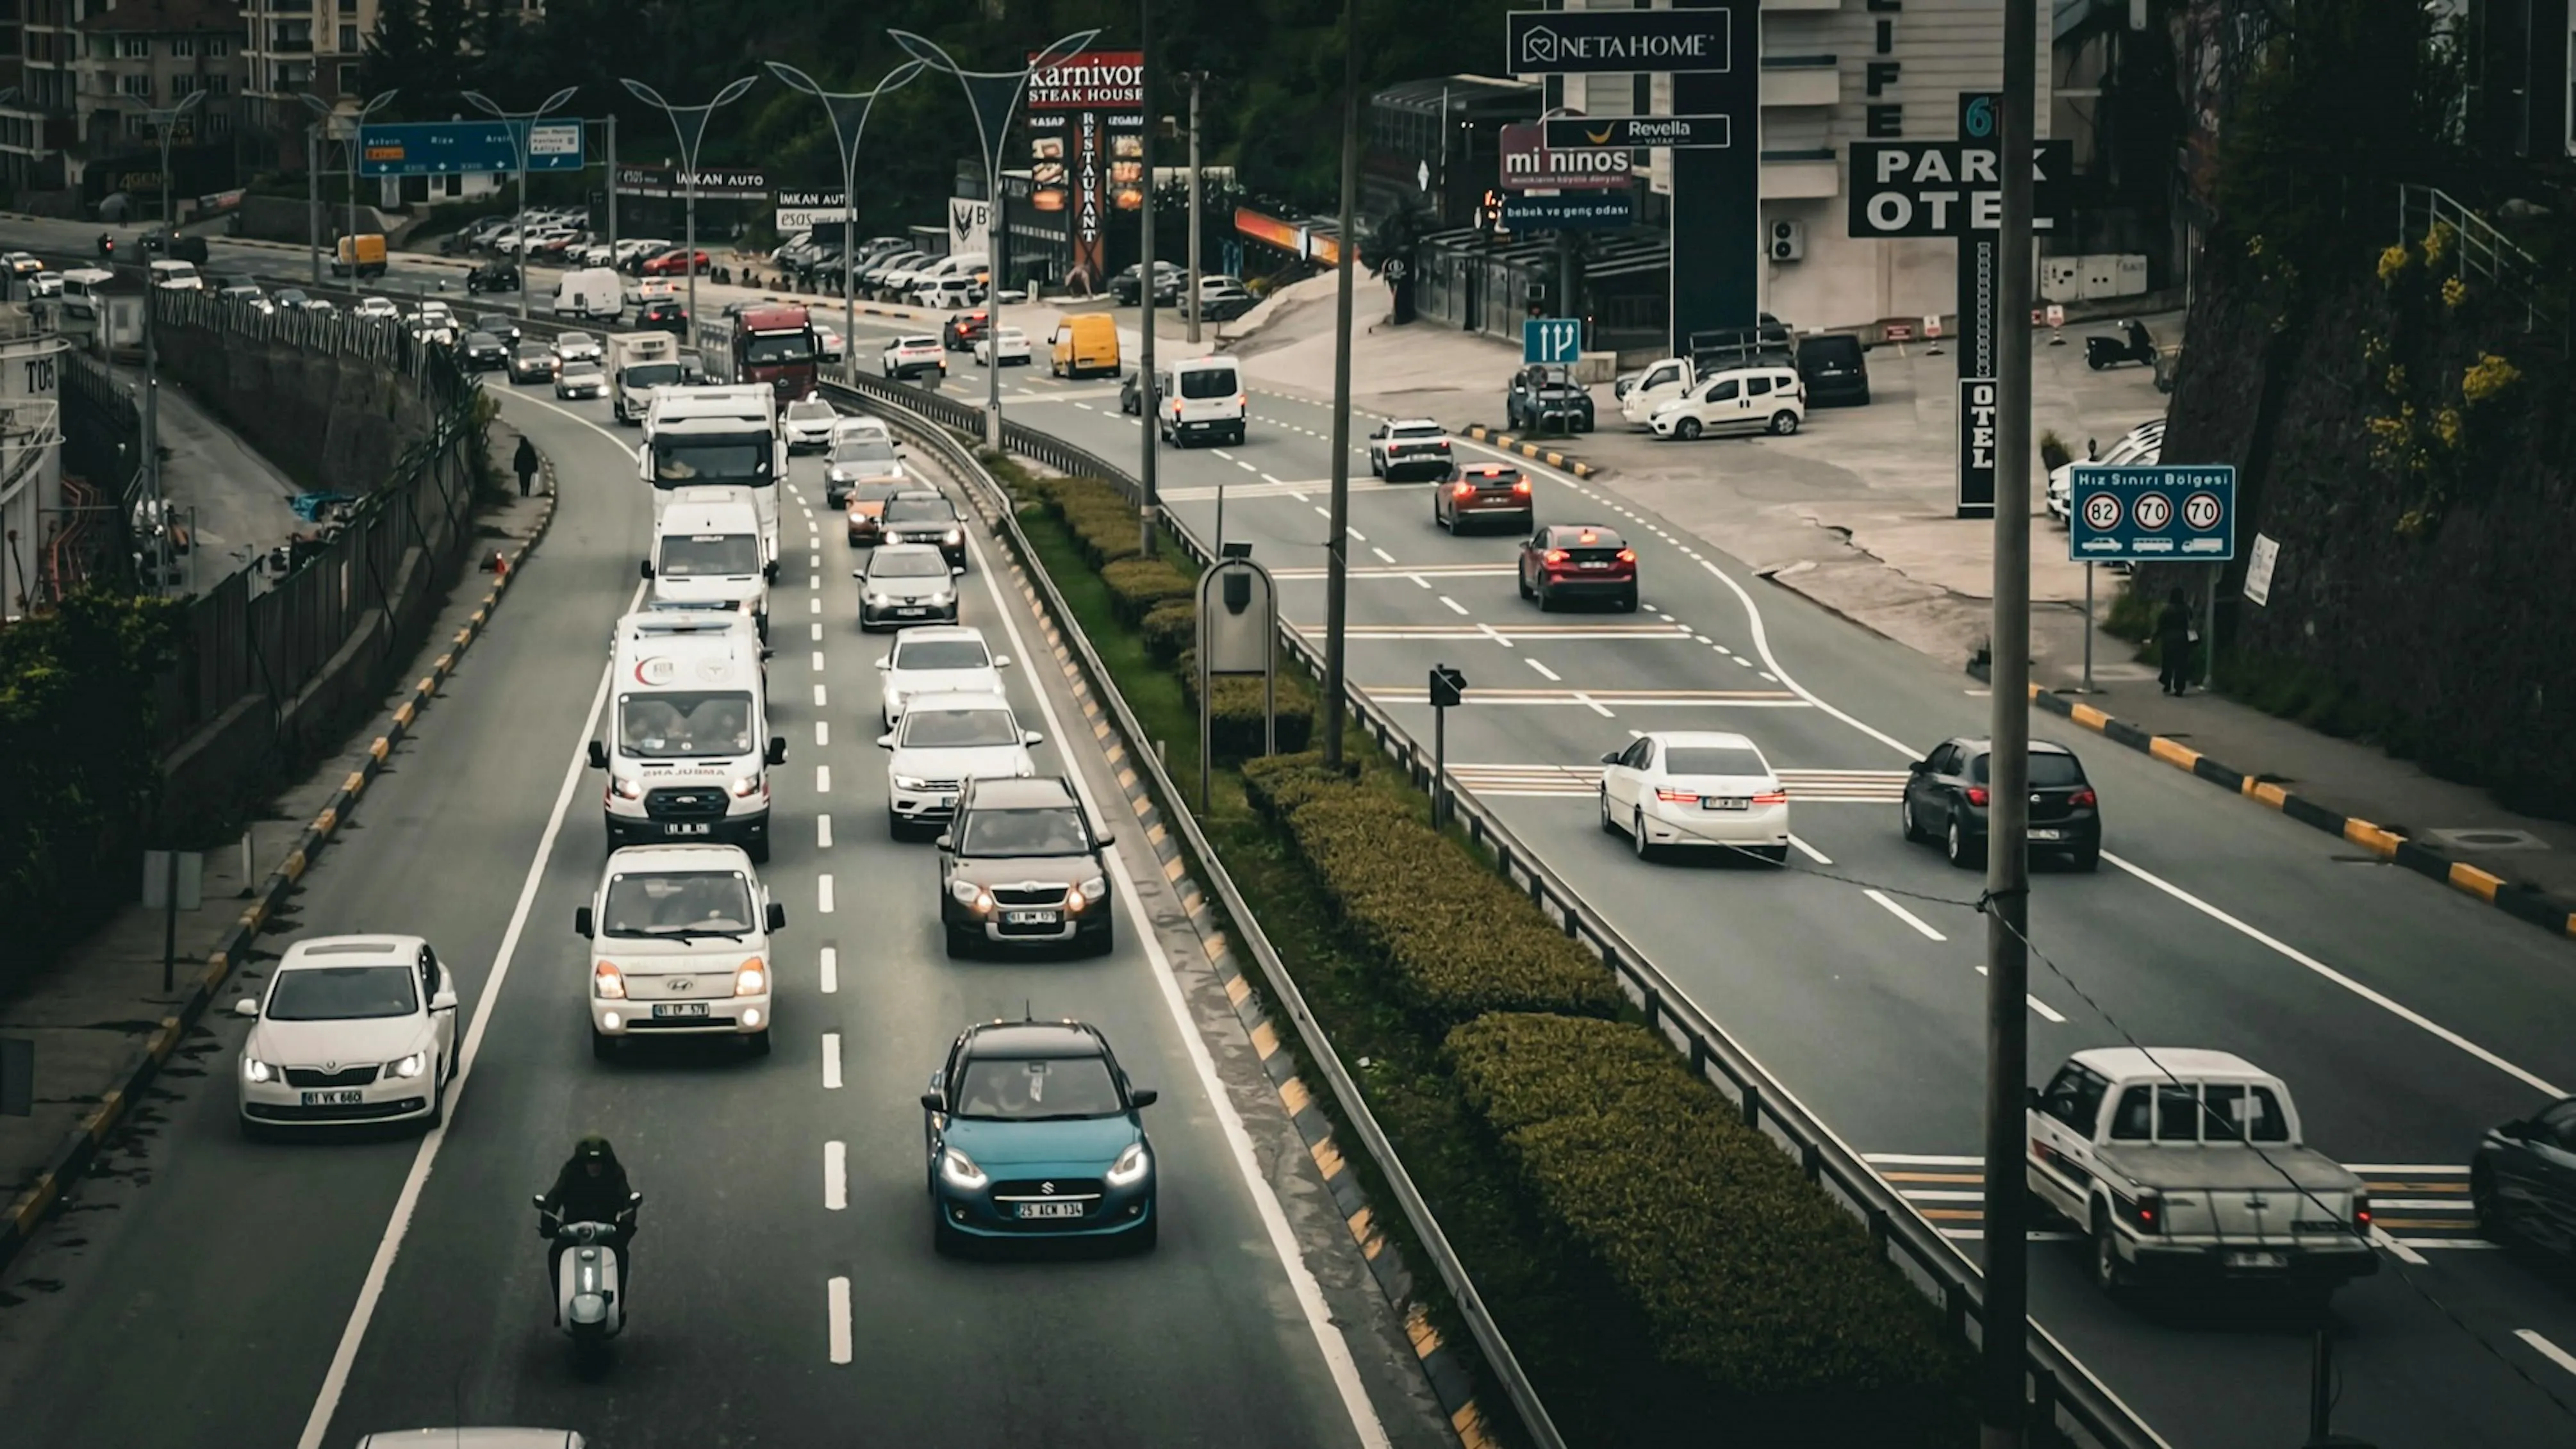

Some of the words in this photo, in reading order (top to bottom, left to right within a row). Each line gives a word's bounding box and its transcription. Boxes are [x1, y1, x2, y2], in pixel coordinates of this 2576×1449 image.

[1561, 36, 1626, 58] NETA
[1630, 35, 1707, 56] HOME
[1867, 0, 1901, 138] IFE
[1029, 88, 1082, 102] STEAK
[1628, 120, 1691, 137] Revella
[1506, 147, 1539, 173] mi
[1549, 149, 1629, 173] ninos
[727, 175, 764, 186] AUTO
[1082, 112, 1096, 243] RESTAURANT
[822, 194, 846, 205] AUT
[781, 211, 813, 226] esas
[1507, 208, 1543, 218] bebek
[1547, 208, 1560, 217] ve
[1563, 207, 1592, 217] genç
[1596, 205, 1629, 215] odası
[1866, 191, 2054, 231] OTE
[24, 357, 54, 393] T05
[1970, 385, 1995, 468] OTEL
[2078, 473, 2106, 486] Hız
[2111, 473, 2159, 486] Sınırı
[2165, 473, 2228, 488] Bölgesi
[2091, 503, 2113, 520] 82
[2142, 503, 2166, 520] 70
[2191, 503, 2215, 520] 70
[307, 1092, 318, 1103] 61
[322, 1092, 336, 1103] YK
[1021, 1205, 1033, 1216] 25
[1064, 1204, 1081, 1215] 134
